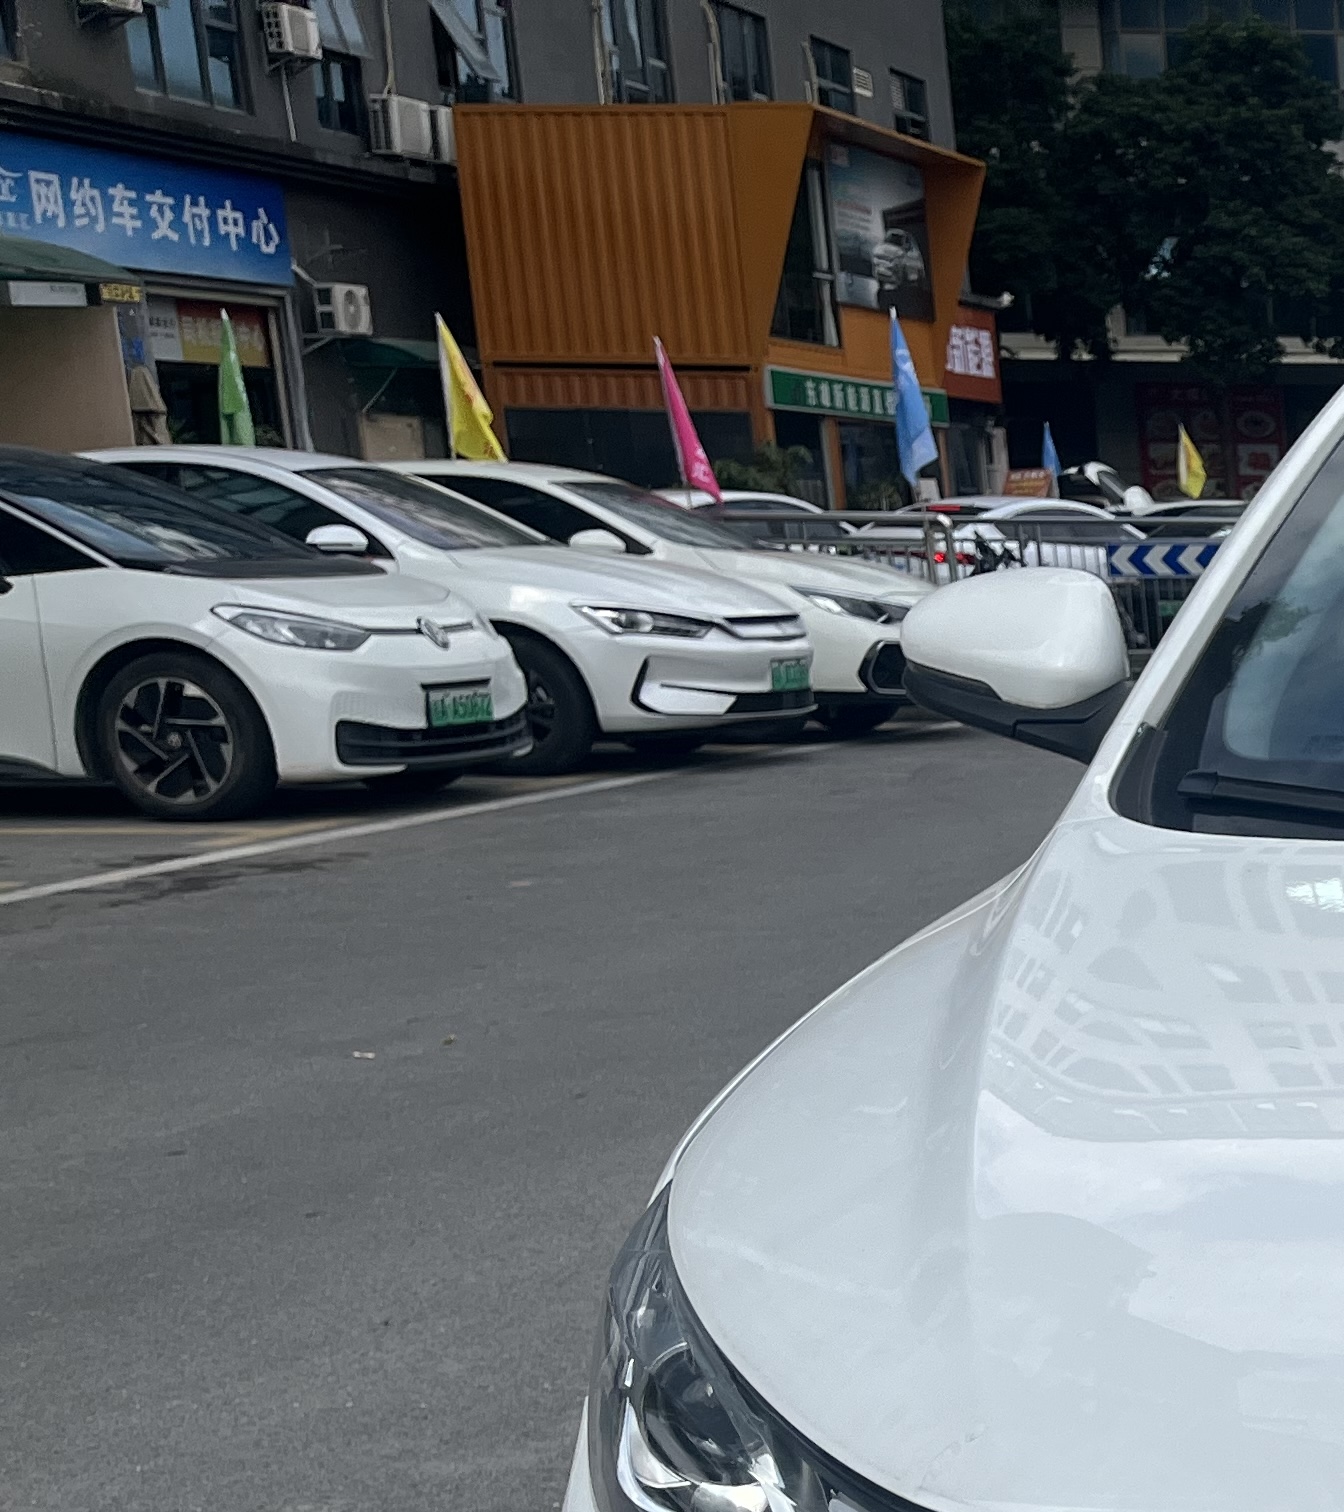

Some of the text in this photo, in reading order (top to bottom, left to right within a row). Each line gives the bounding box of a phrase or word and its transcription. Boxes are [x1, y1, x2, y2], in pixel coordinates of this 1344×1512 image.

[28, 169, 280, 255] 网约车交付中心
